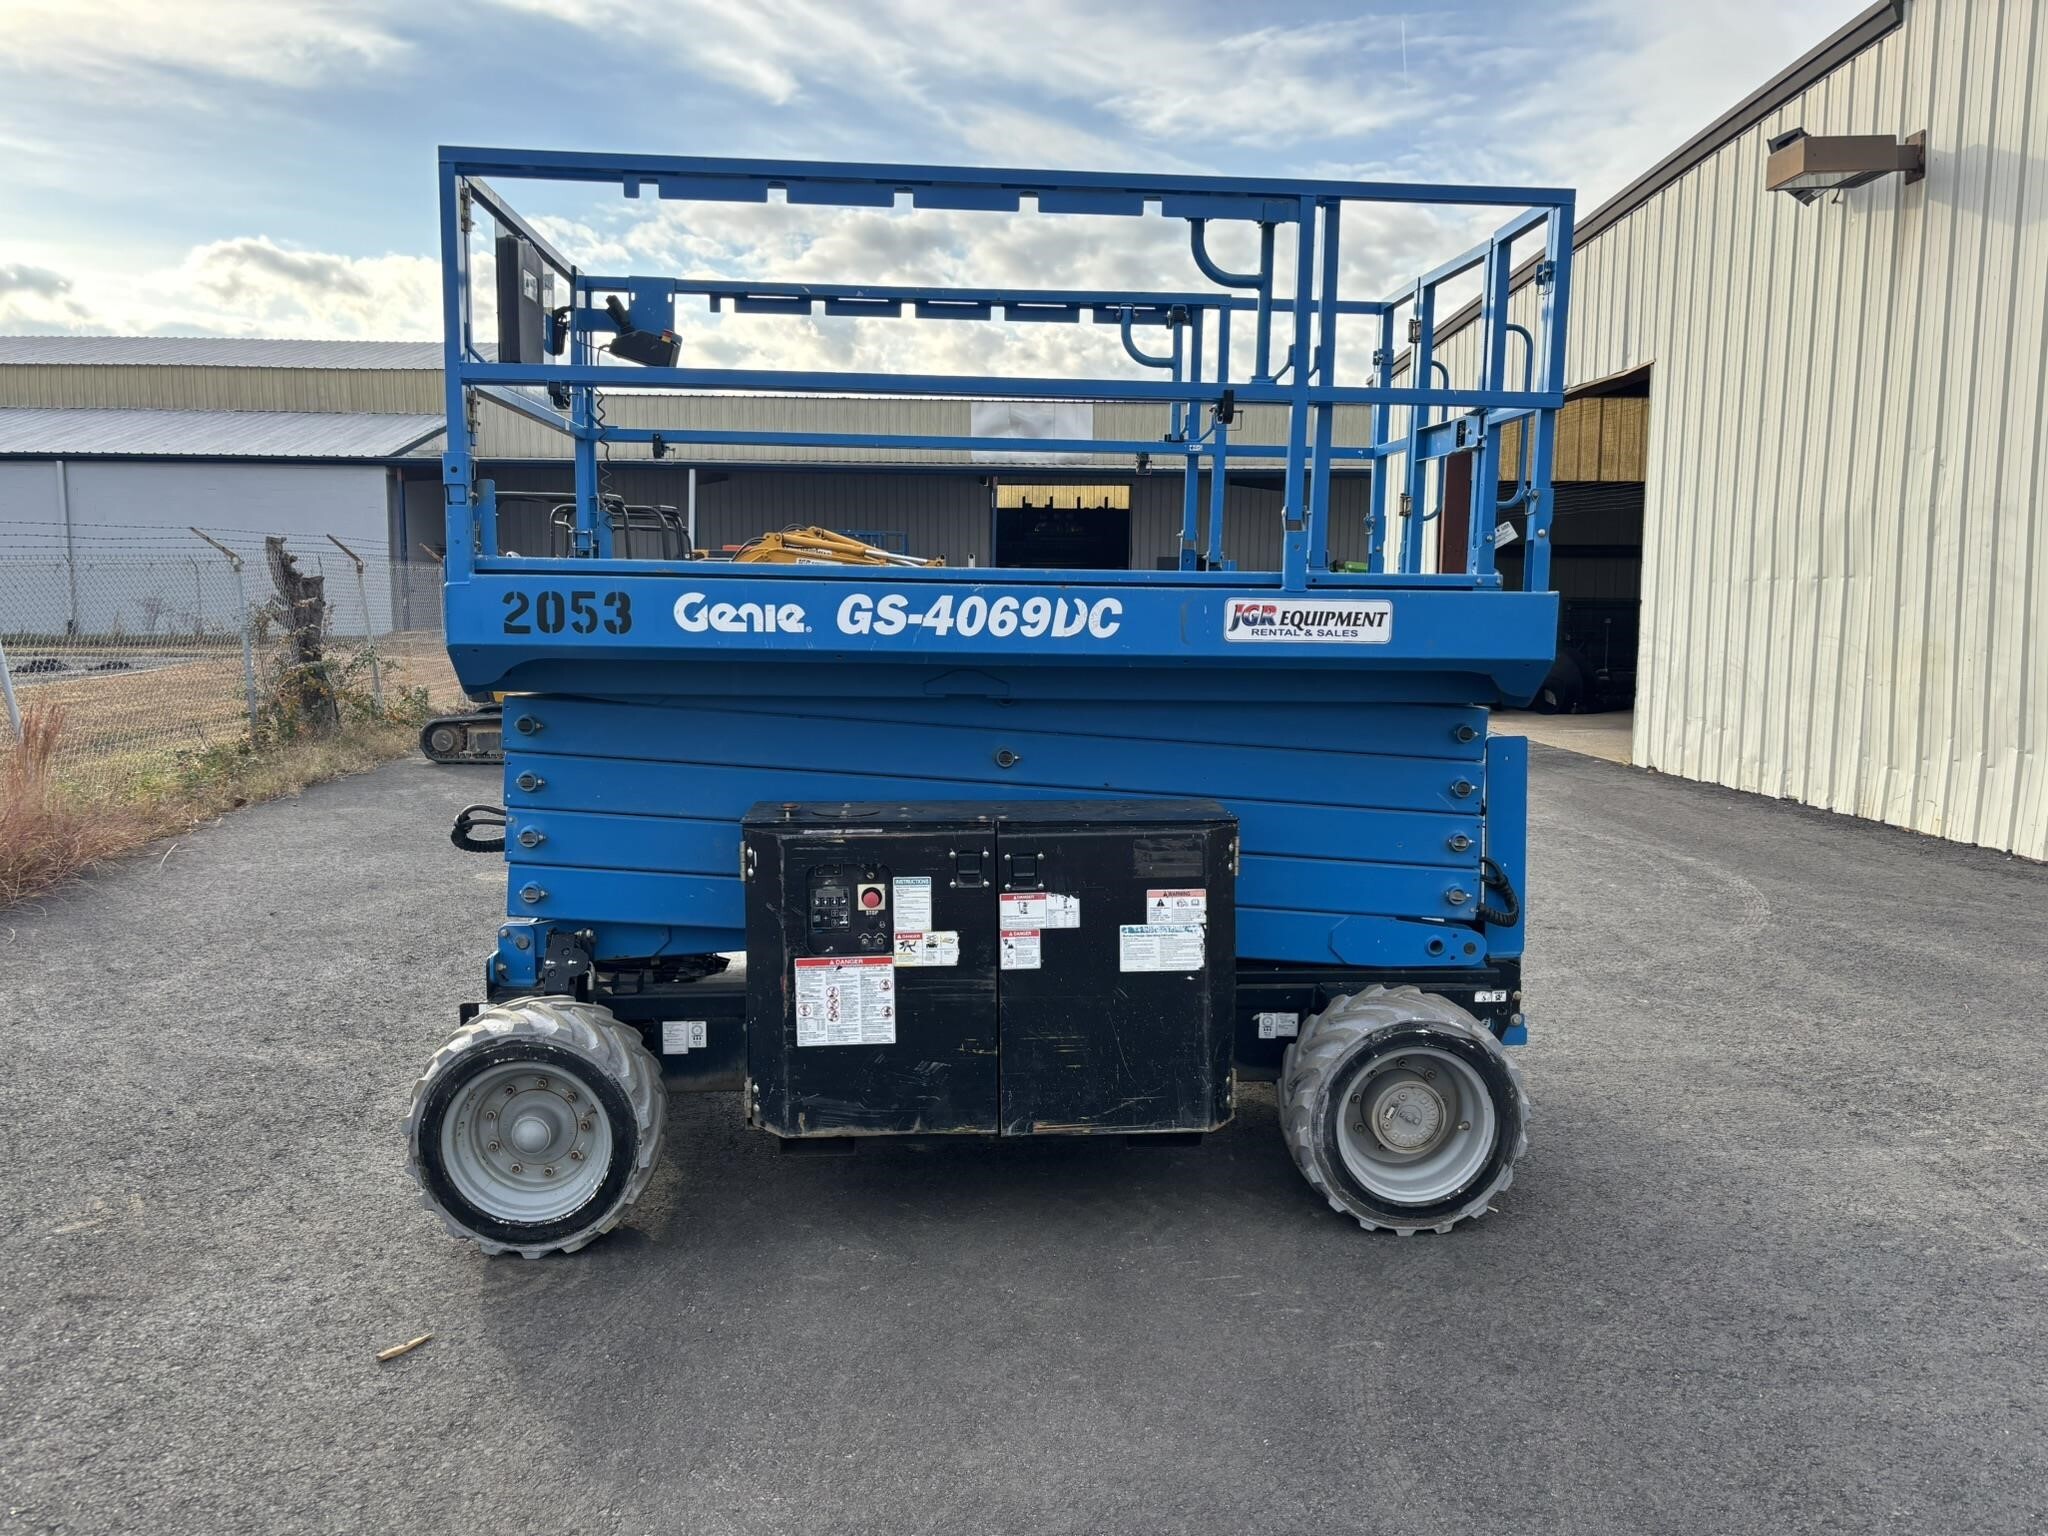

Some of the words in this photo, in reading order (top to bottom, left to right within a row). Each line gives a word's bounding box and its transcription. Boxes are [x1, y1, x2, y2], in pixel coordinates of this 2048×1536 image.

[502, 591, 632, 635] 2053
[673, 592, 807, 633] Genie
[836, 593, 1124, 639] GS-4069DC
[1228, 604, 1278, 632] JGR
[1279, 610, 1389, 631] EQUIPMENT
[1251, 628, 1301, 637] RENTAL
[1304, 628, 1313, 637] &
[1316, 629, 1359, 638] SALES
